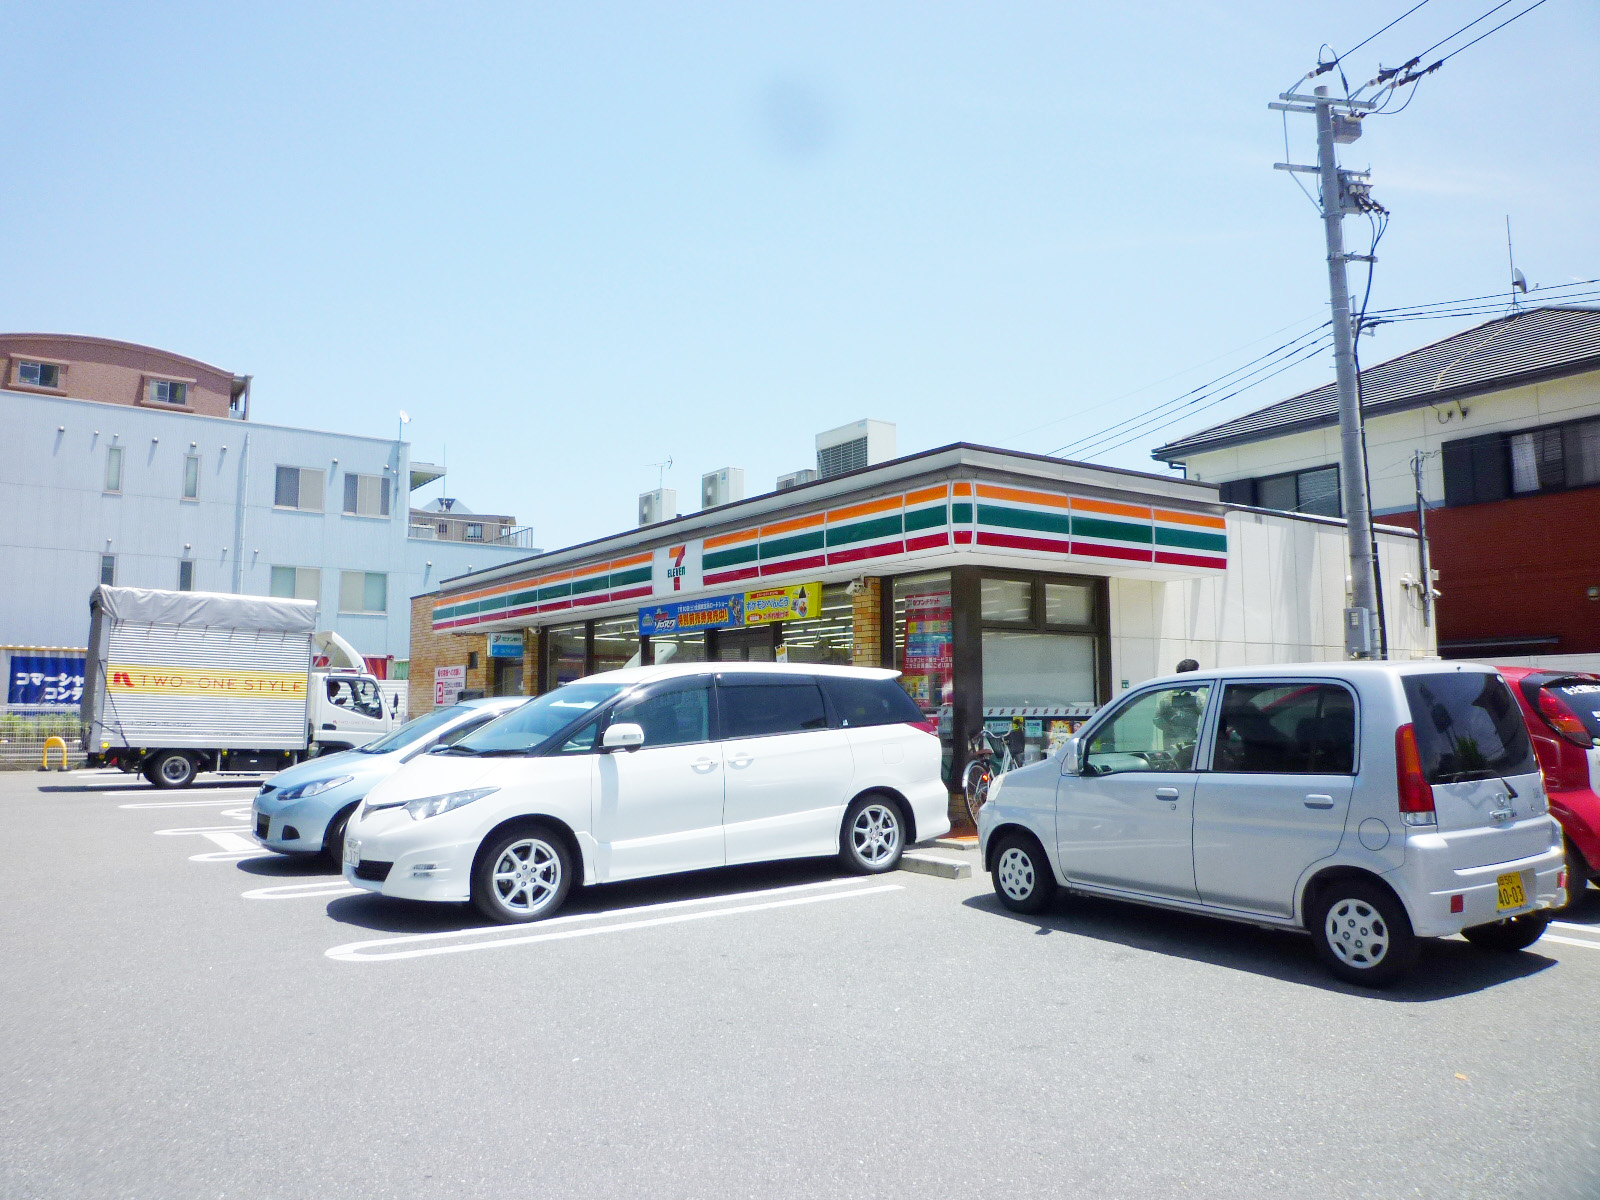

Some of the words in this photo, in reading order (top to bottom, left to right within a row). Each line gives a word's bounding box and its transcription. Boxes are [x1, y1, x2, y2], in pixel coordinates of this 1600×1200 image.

[669, 544, 686, 591] 7
[140, 675, 237, 690] TWO-ONE
[244, 680, 303, 692] STYLE
